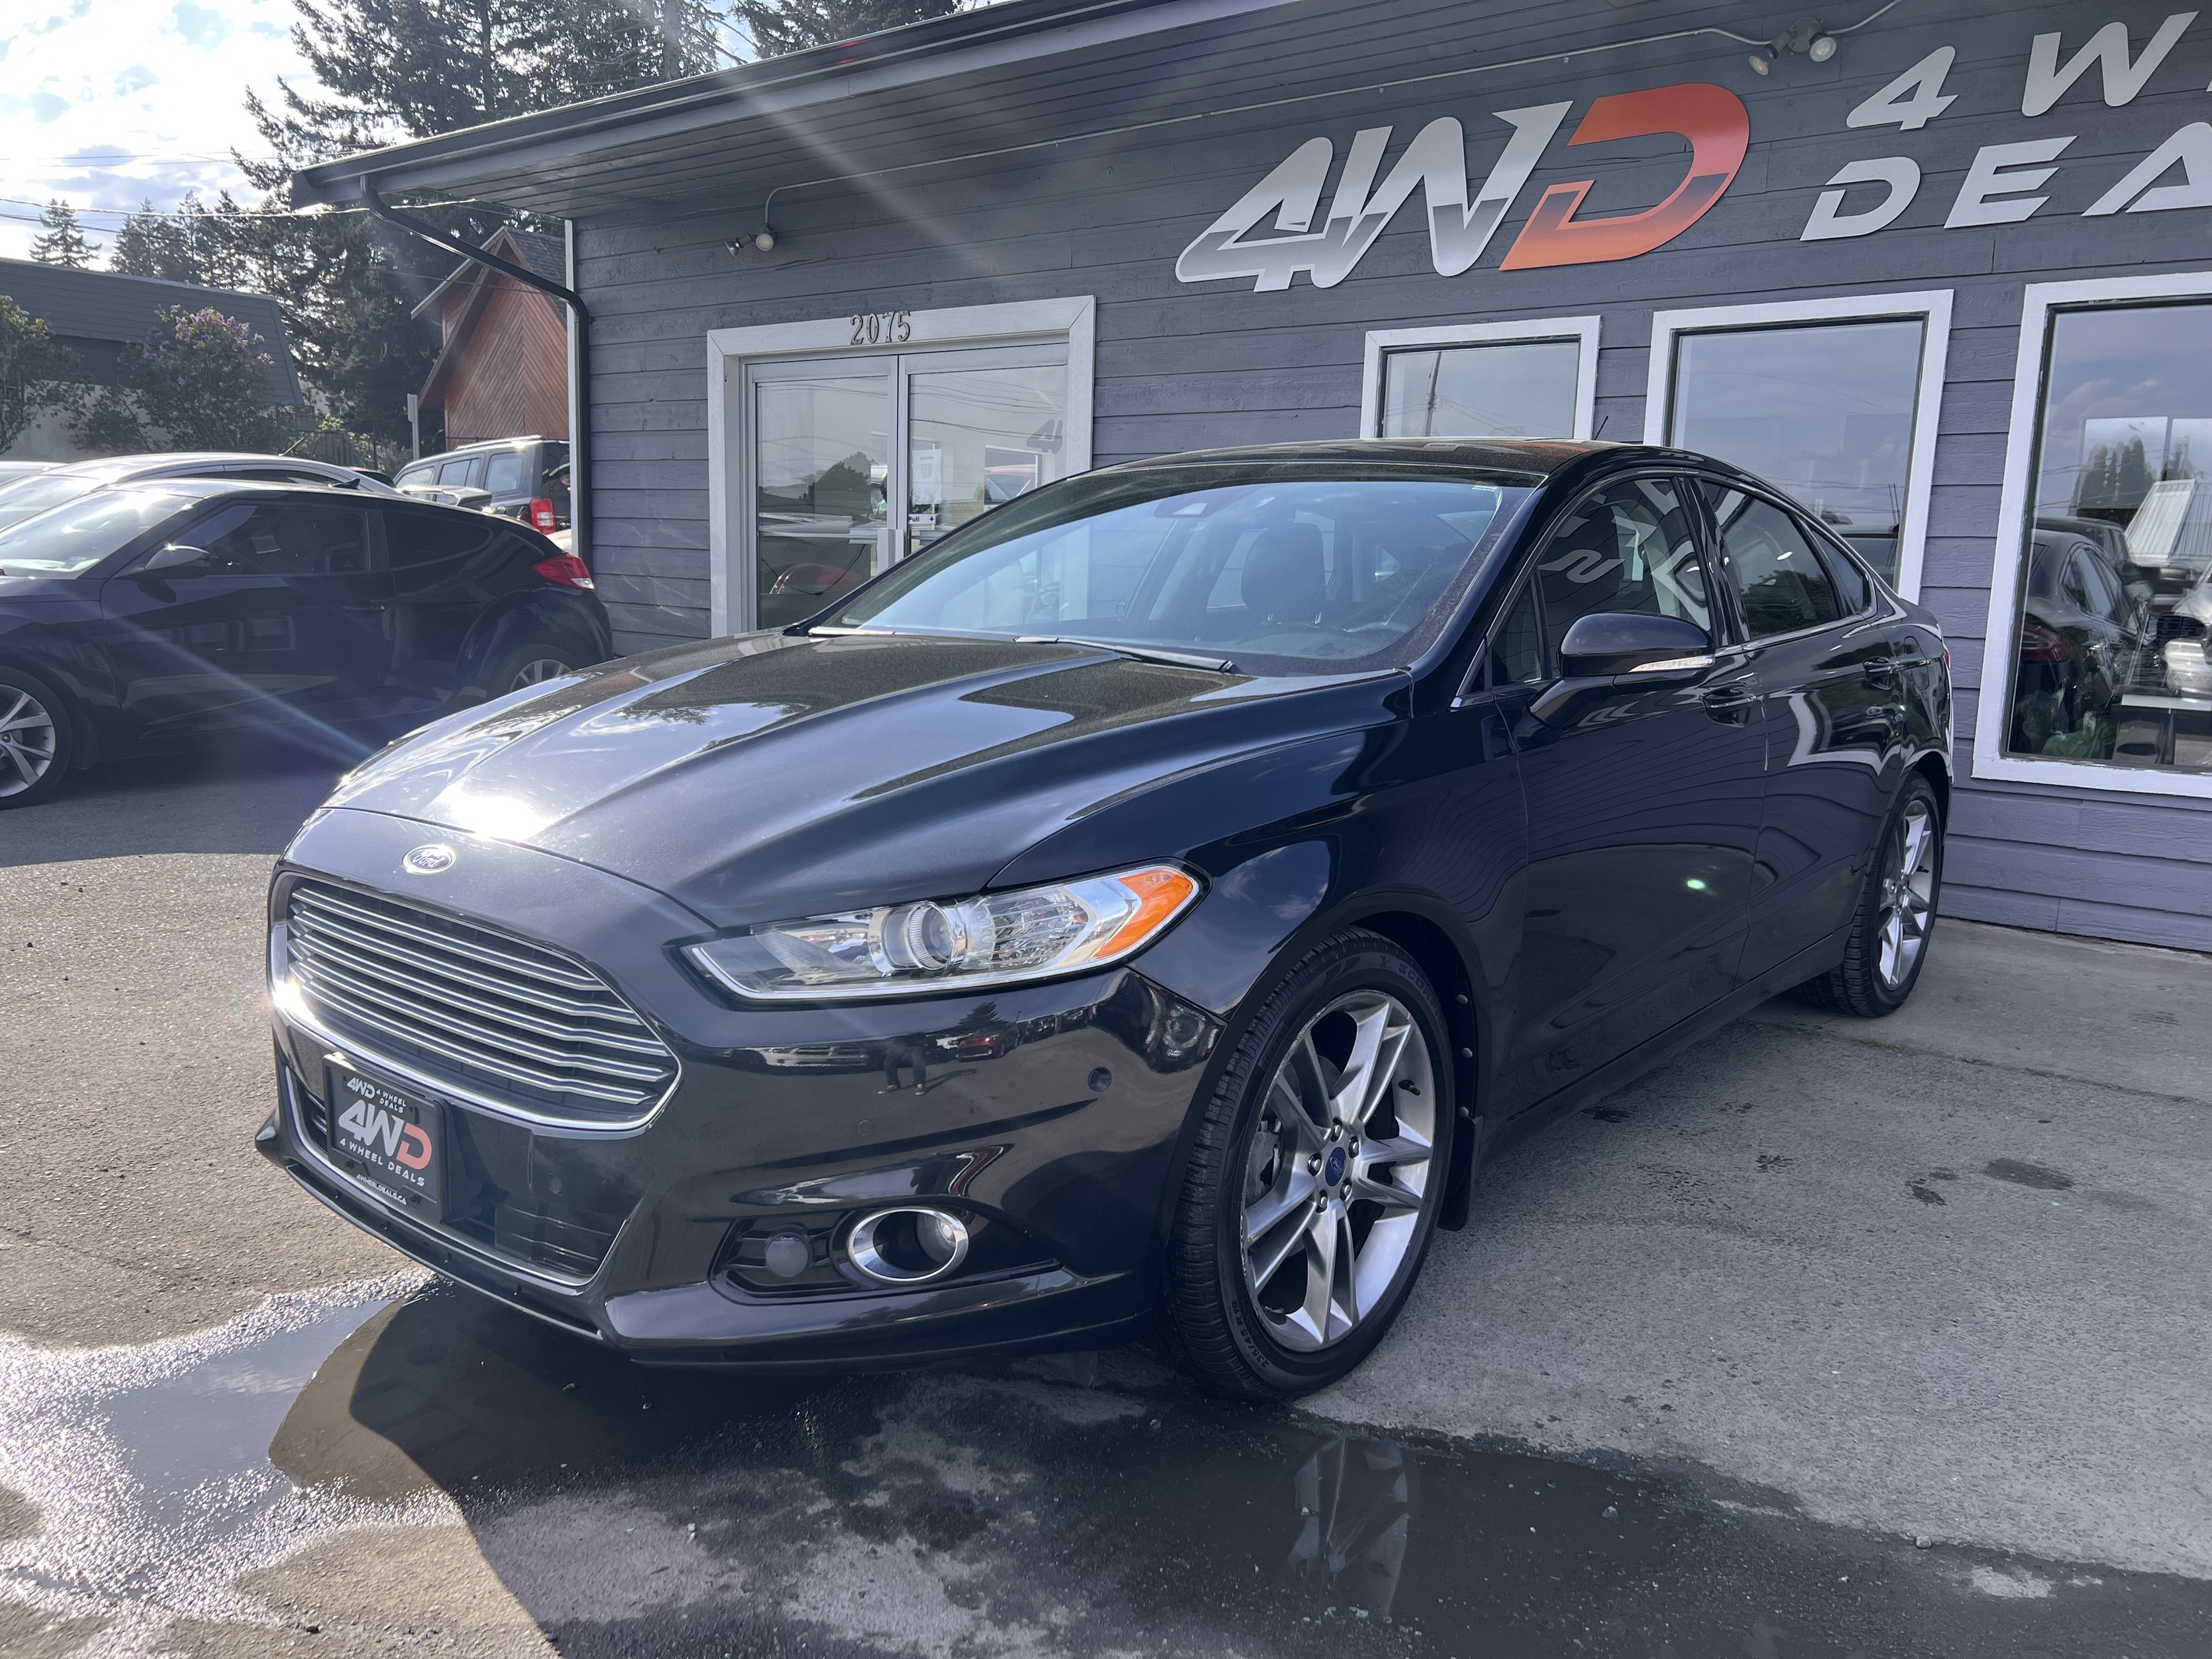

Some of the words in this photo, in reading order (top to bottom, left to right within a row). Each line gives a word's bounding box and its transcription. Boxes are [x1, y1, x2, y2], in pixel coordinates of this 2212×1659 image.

[1846, 45, 1959, 131] 4
[2022, 11, 2212, 117] W
[1176, 81, 1751, 293] 4WD
[850, 310, 911, 345] 2075
[411, 850, 445, 869] Ford
[347, 1077, 376, 1099] 4WD
[379, 1097, 404, 1114] DEALS
[382, 1091, 406, 1107] WHEEL
[338, 1099, 432, 1170] 4WD
[339, 1137, 346, 1147] 4
[349, 1141, 384, 1166] WHEEL
[387, 1161, 426, 1187] DEALS
[1240, 1329, 1270, 1367] 235/45
